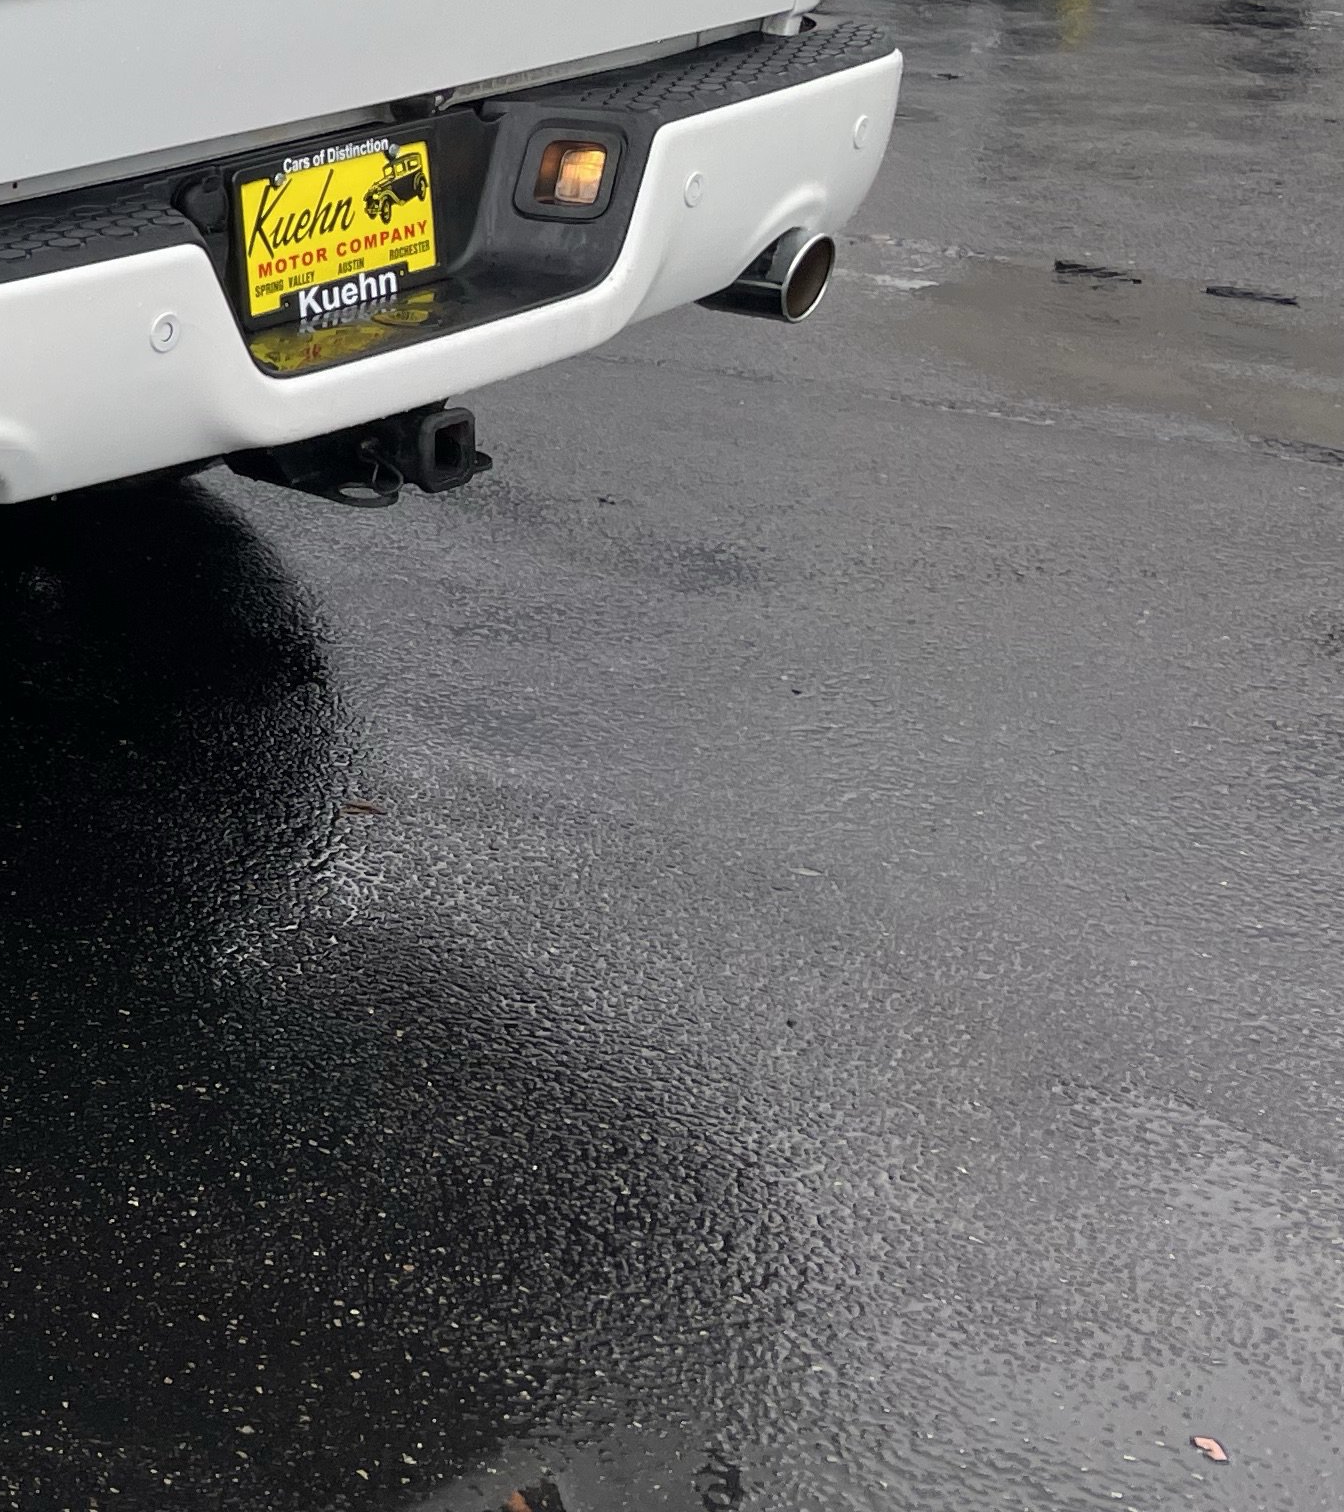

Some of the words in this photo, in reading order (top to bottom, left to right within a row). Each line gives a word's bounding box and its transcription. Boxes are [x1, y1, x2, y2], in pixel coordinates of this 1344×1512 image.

[283, 157, 310, 174] Cars
[312, 149, 326, 166] of
[327, 138, 389, 164] Distinction
[248, 168, 355, 259] Kuehn
[255, 279, 284, 298] SPRING
[288, 270, 315, 289] VALLEY
[338, 257, 365, 276] AUSTIN
[389, 239, 430, 261] ROCHESTER
[258, 247, 328, 278] MOTOR
[336, 220, 428, 257] COMPANY
[298, 271, 398, 319] Kuehn
